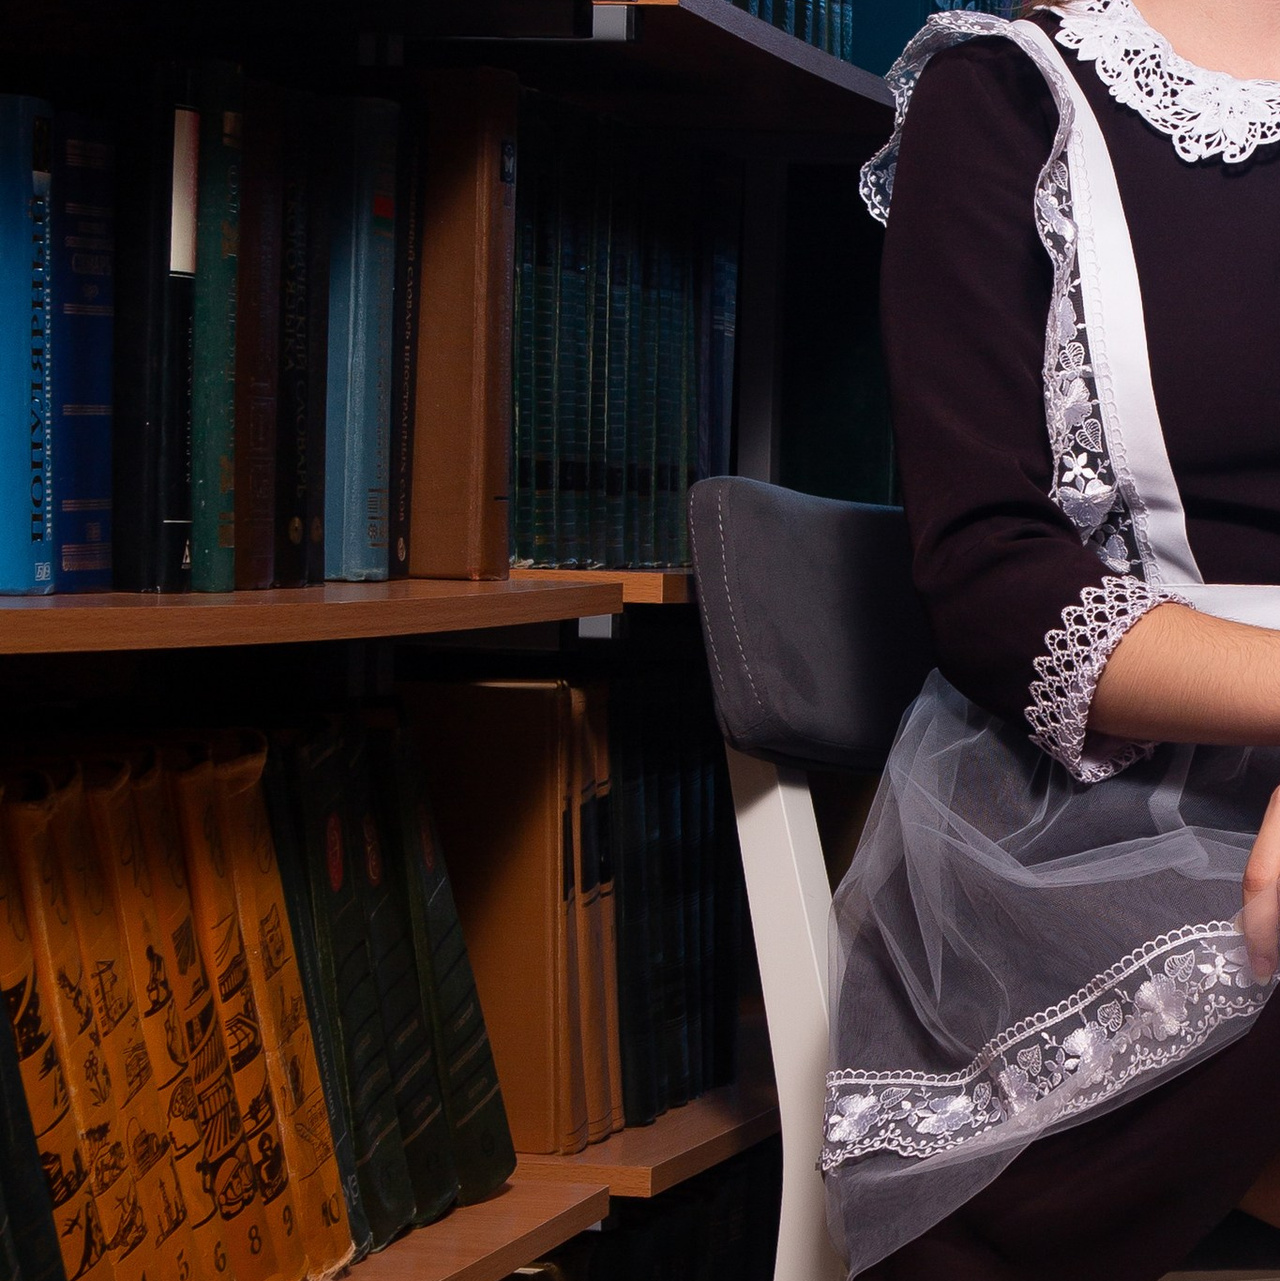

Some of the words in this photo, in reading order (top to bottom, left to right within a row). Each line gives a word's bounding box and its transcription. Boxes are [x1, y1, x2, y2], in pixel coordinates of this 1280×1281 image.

[28, 193, 44, 544] ПОПУЛЯРНЫЙ
[283, 1205, 295, 1237] 9
[320, 1193, 341, 1228] 10
[248, 1224, 262, 1255] 8
[176, 1249, 189, 1281] 5
[213, 1240, 227, 1273] 6
